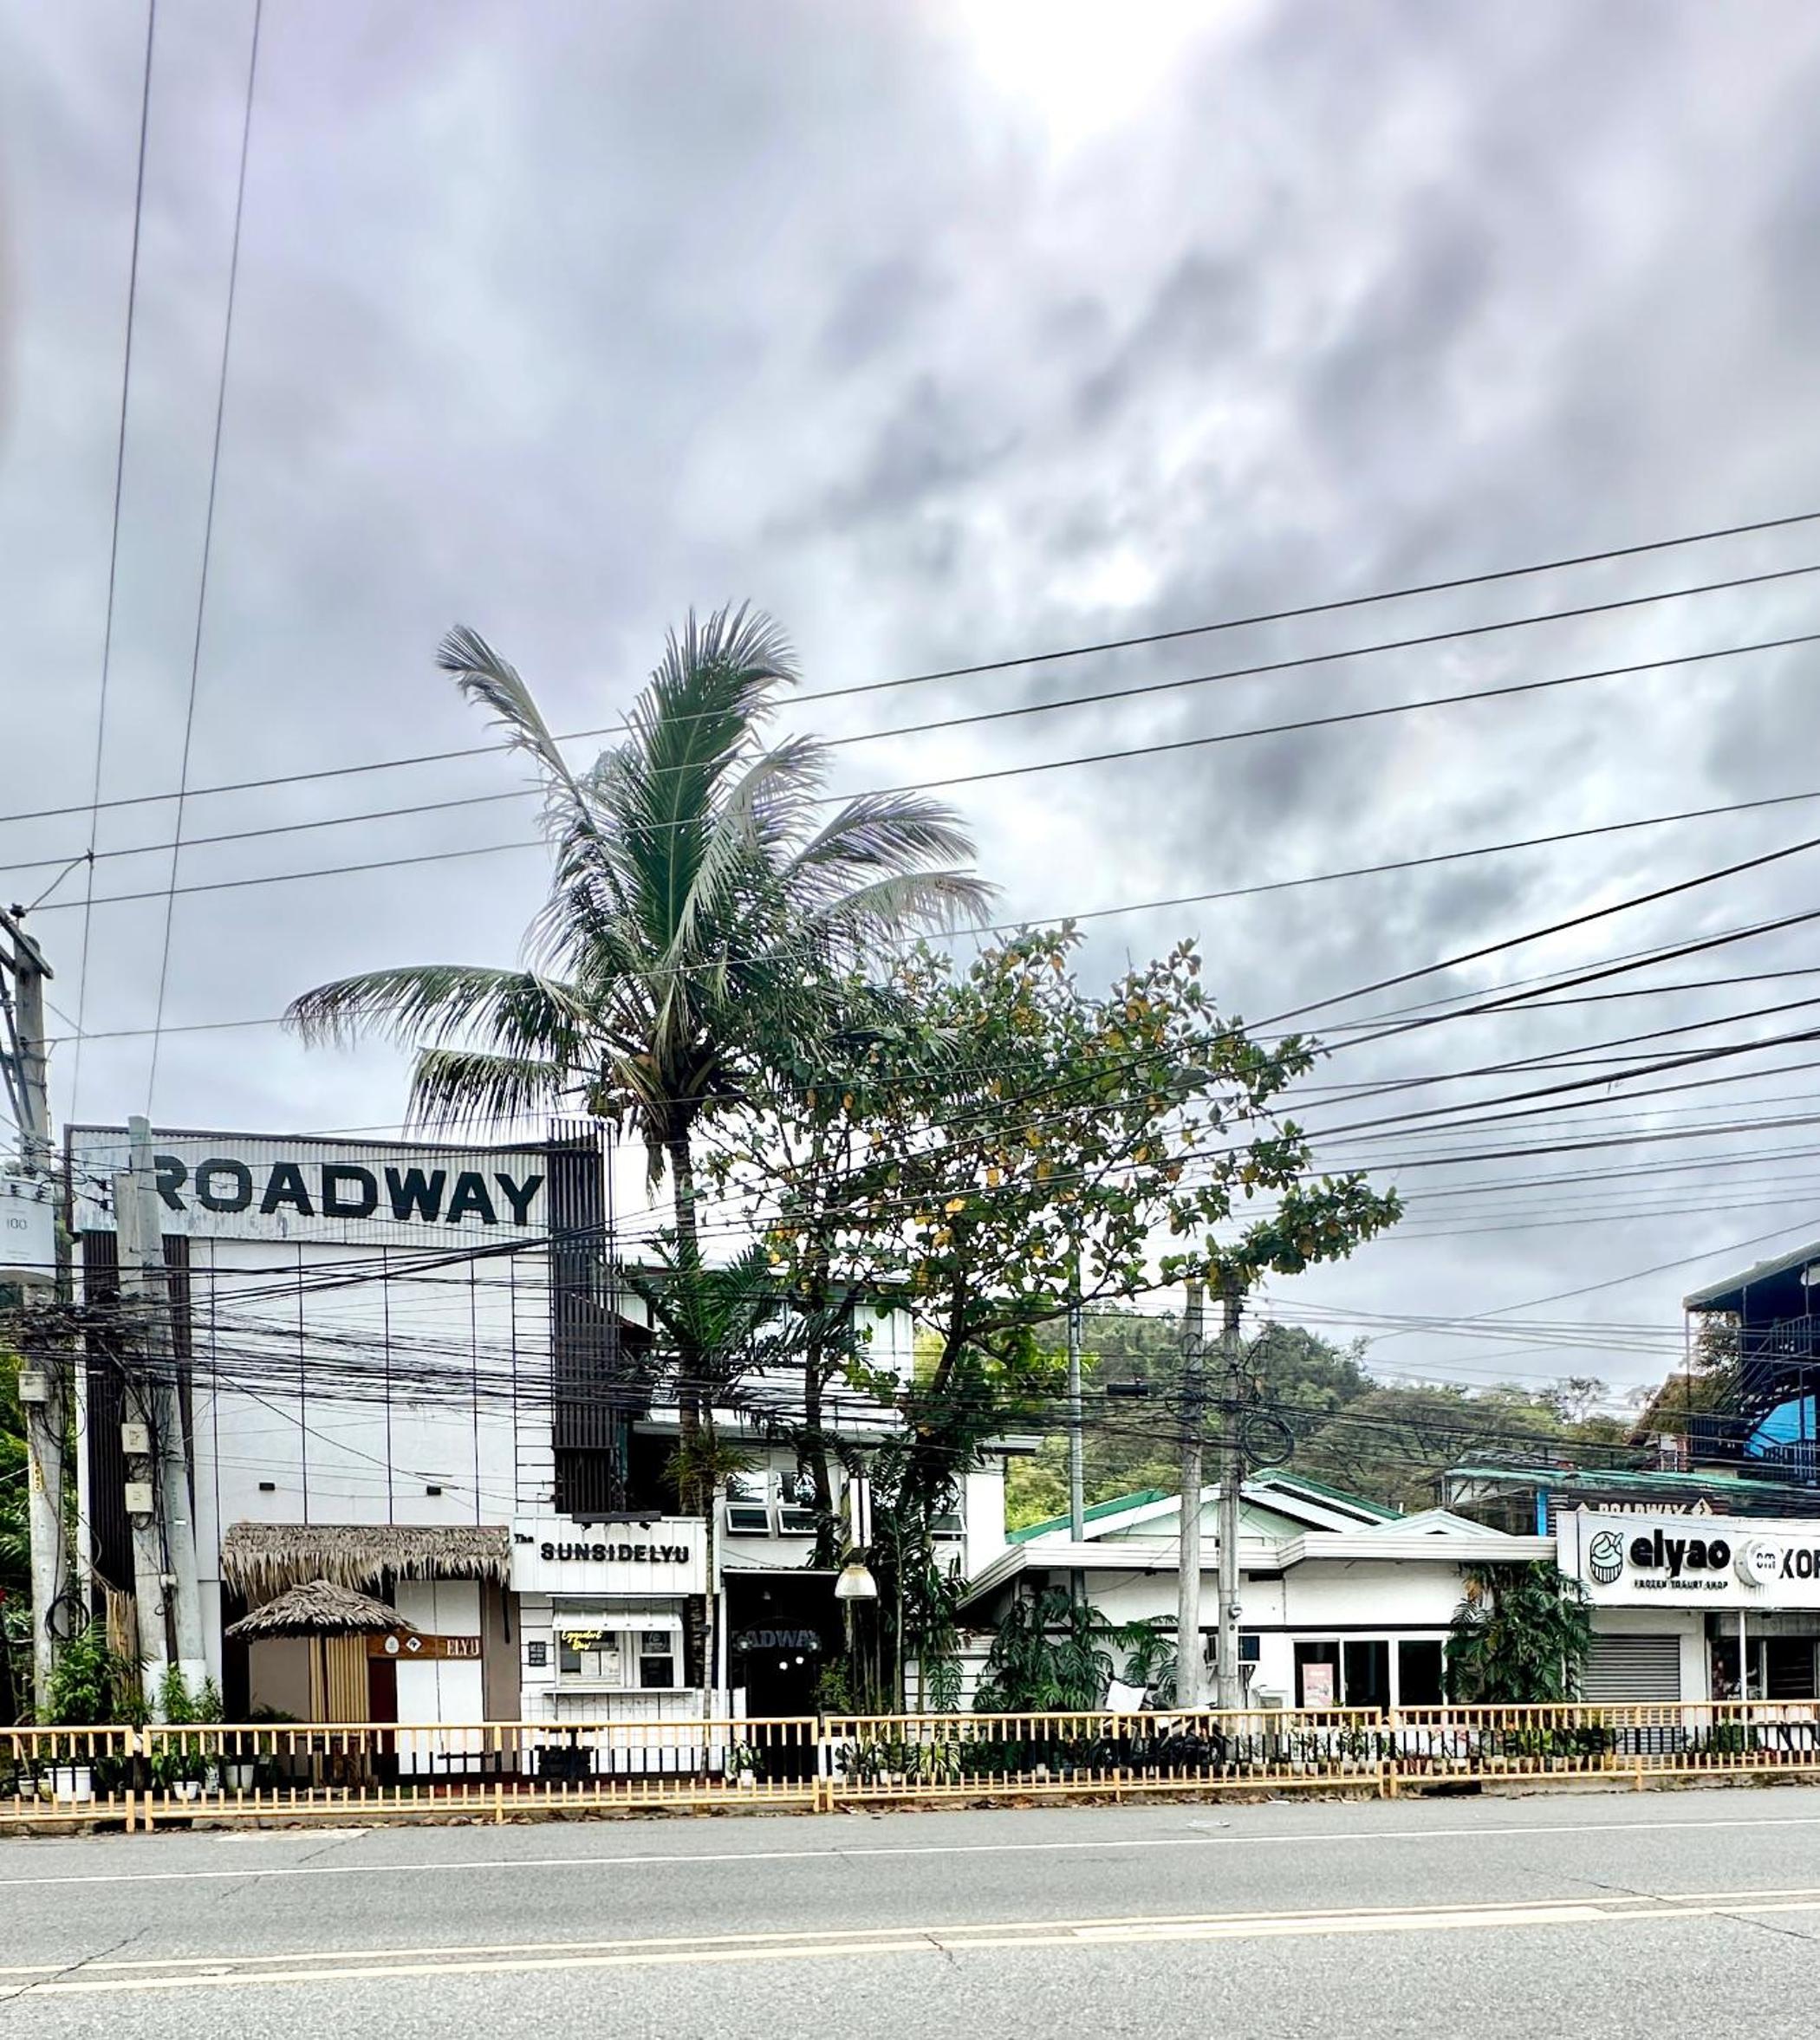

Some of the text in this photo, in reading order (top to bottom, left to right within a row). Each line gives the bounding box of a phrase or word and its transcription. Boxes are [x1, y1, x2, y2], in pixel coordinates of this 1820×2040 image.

[514, 1534, 534, 1543] The
[541, 1543, 689, 1564] SUNSIDELYU
[1630, 1529, 1731, 1577] elyao
[446, 1640, 480, 1656] ELYU
